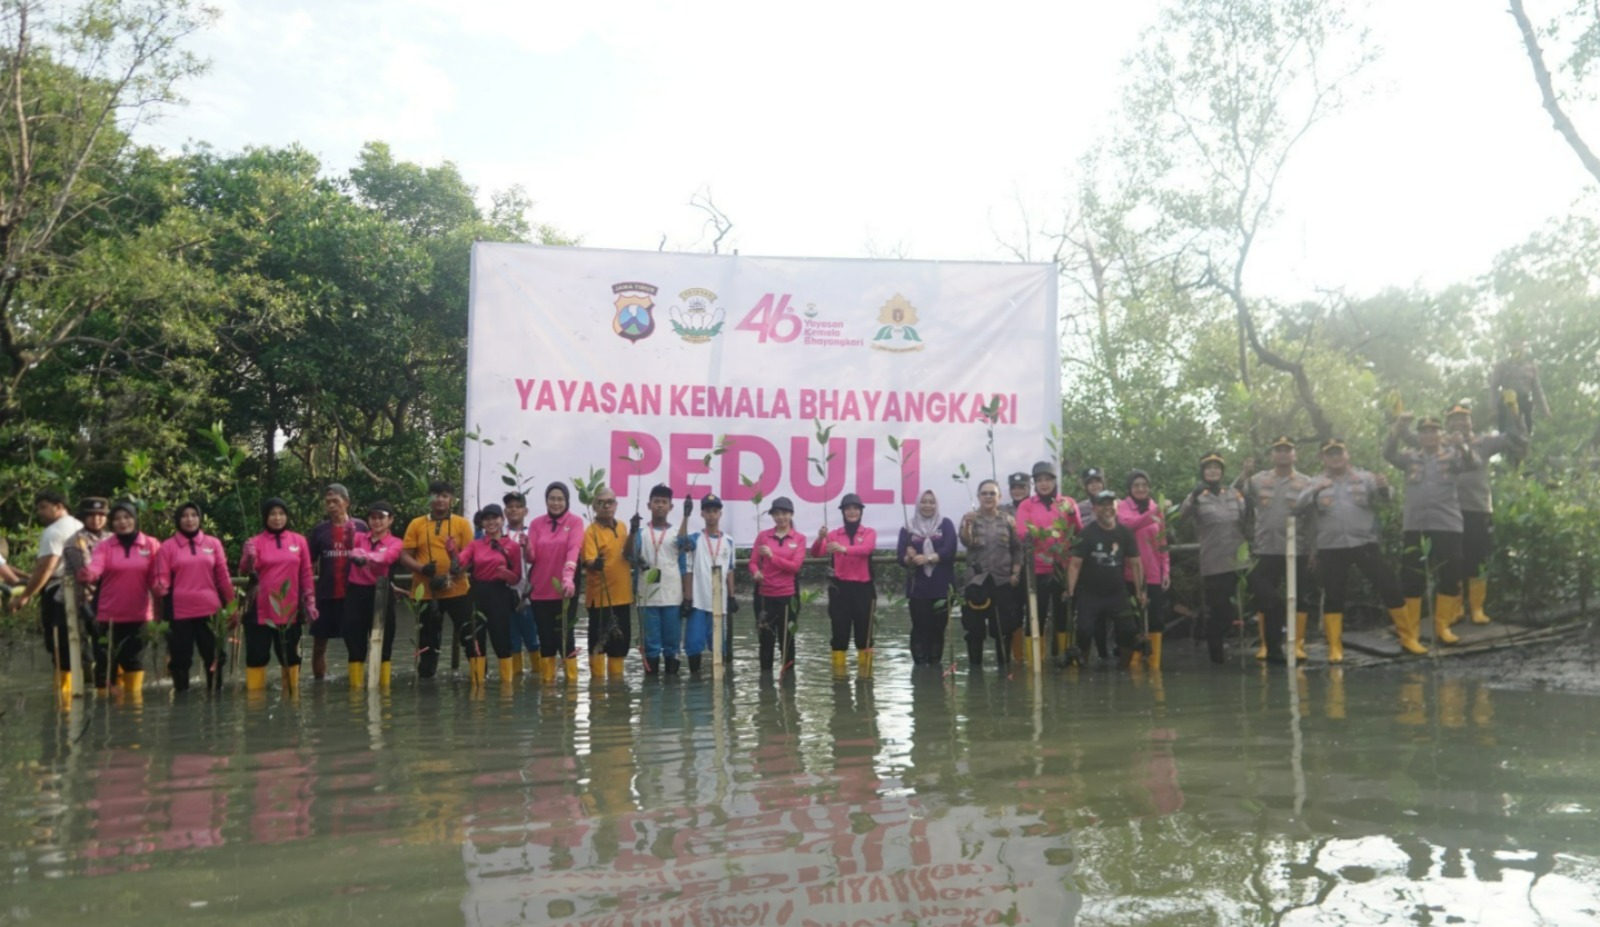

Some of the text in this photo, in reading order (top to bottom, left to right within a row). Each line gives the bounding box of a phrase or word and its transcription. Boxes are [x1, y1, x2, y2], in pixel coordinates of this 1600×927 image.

[803, 319, 844, 329] Yayasan
[803, 328, 841, 337] Kemala
[803, 337, 865, 347] Bhayangkari
[515, 378, 1018, 425] YAYASAN KEMALA BHAYANGKARI
[609, 430, 922, 505] PEDULI
